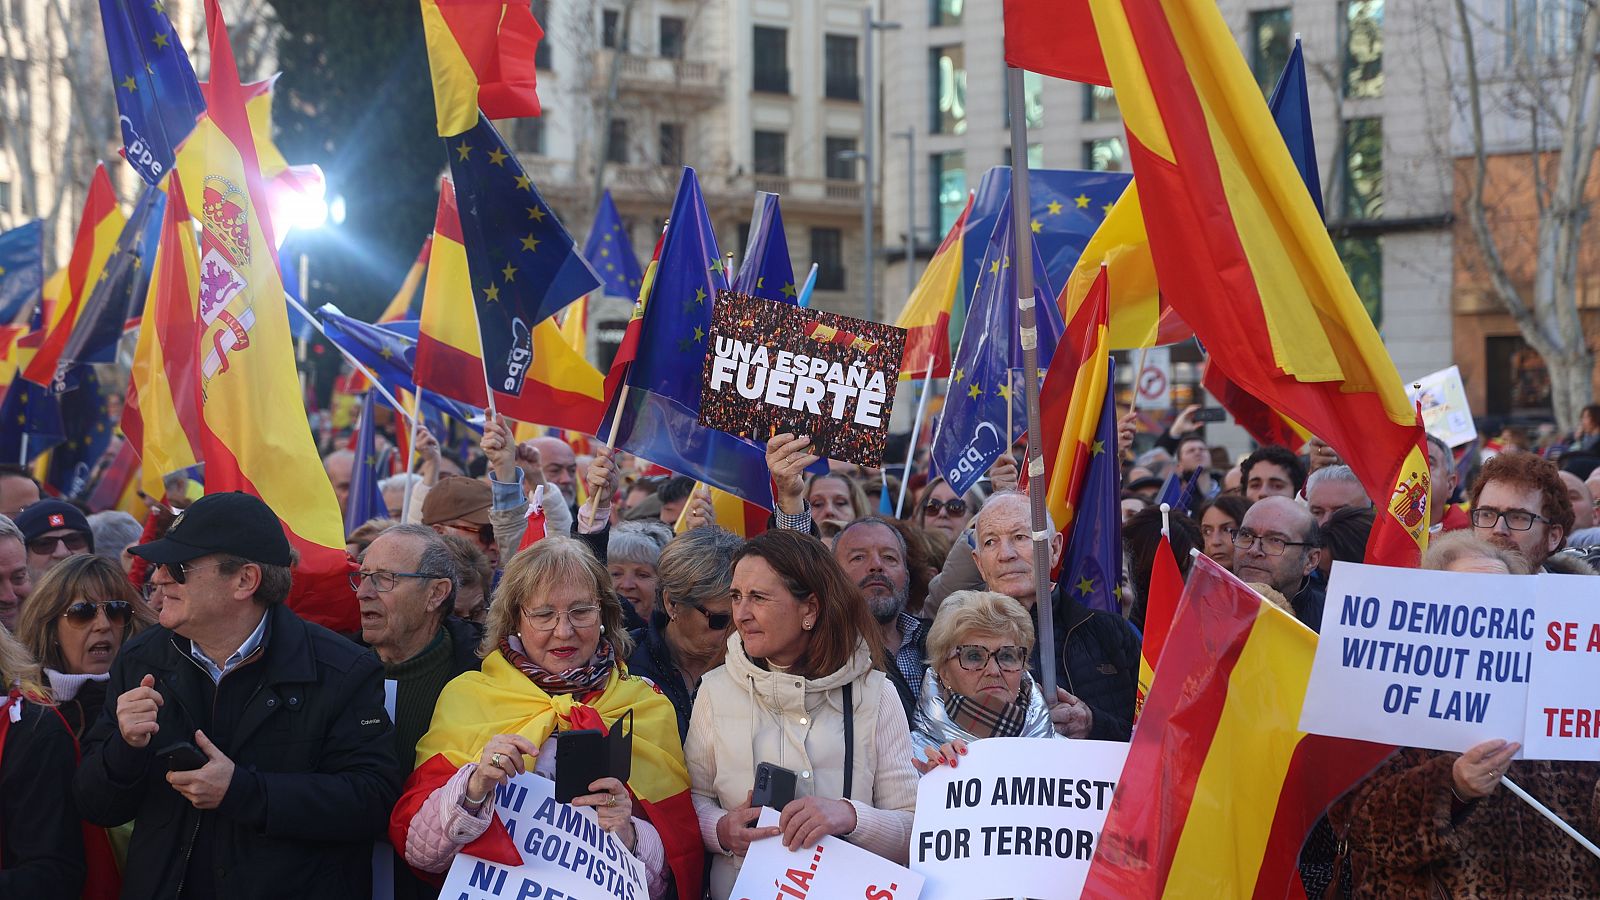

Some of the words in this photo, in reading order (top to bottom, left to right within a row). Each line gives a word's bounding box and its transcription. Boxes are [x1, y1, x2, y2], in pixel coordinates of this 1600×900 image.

[129, 140, 162, 175] ppe
[715, 336, 769, 368] UNA
[776, 350, 886, 394] ESPAÑA
[711, 356, 886, 427] FUERTE
[1340, 595, 1380, 628] NO
[1546, 621, 1578, 652] SE
[1342, 637, 1470, 680] WITHOUT
[1476, 650, 1532, 683] RUL
[1383, 684, 1422, 715] OF
[1428, 689, 1491, 723] LAW
[495, 782, 529, 813] NI
[946, 778, 982, 809] NO
[918, 828, 971, 863] FOR
[981, 826, 1148, 862] TERROR
[469, 860, 509, 896] NI
[523, 827, 635, 900] GOLPISTAS
